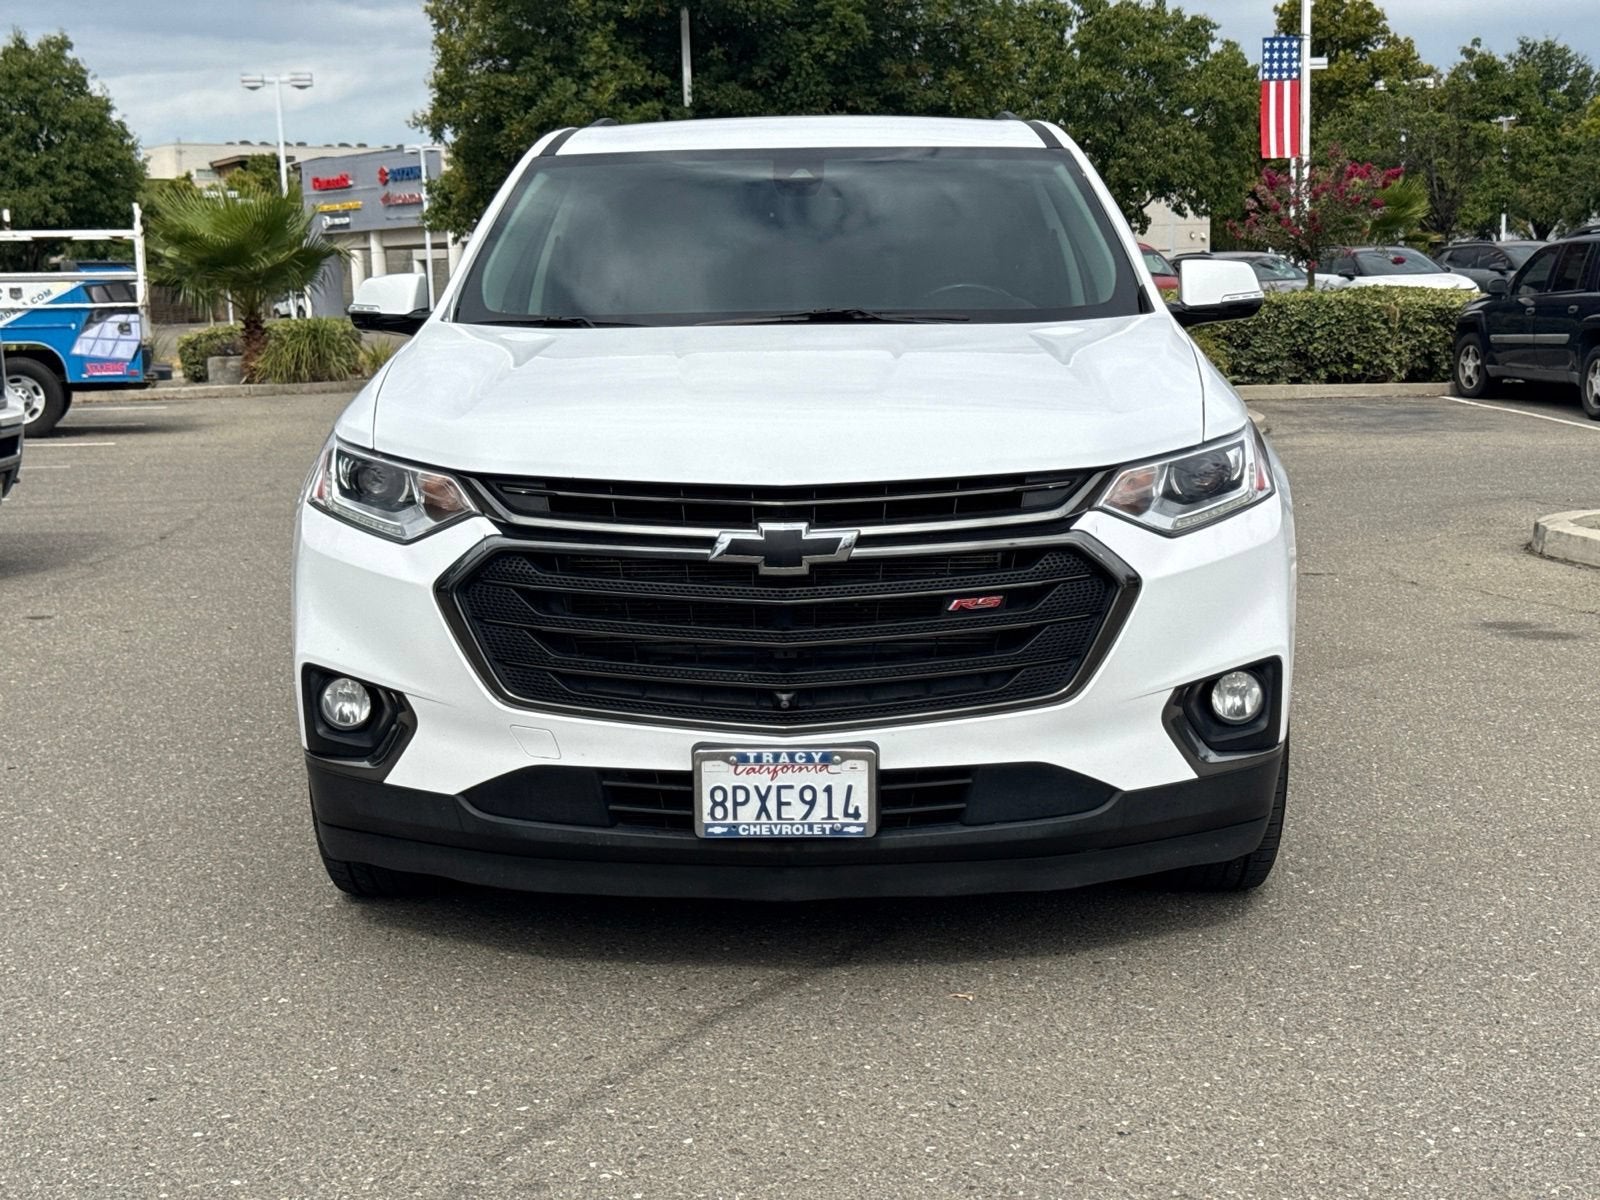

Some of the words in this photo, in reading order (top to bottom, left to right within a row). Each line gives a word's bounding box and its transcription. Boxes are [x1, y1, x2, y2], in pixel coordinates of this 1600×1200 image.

[947, 595, 1003, 611] RS
[747, 752, 823, 763] TRACY
[733, 763, 841, 781] California
[709, 784, 862, 821] 8PXE914
[738, 823, 832, 835] CHEVROLET
